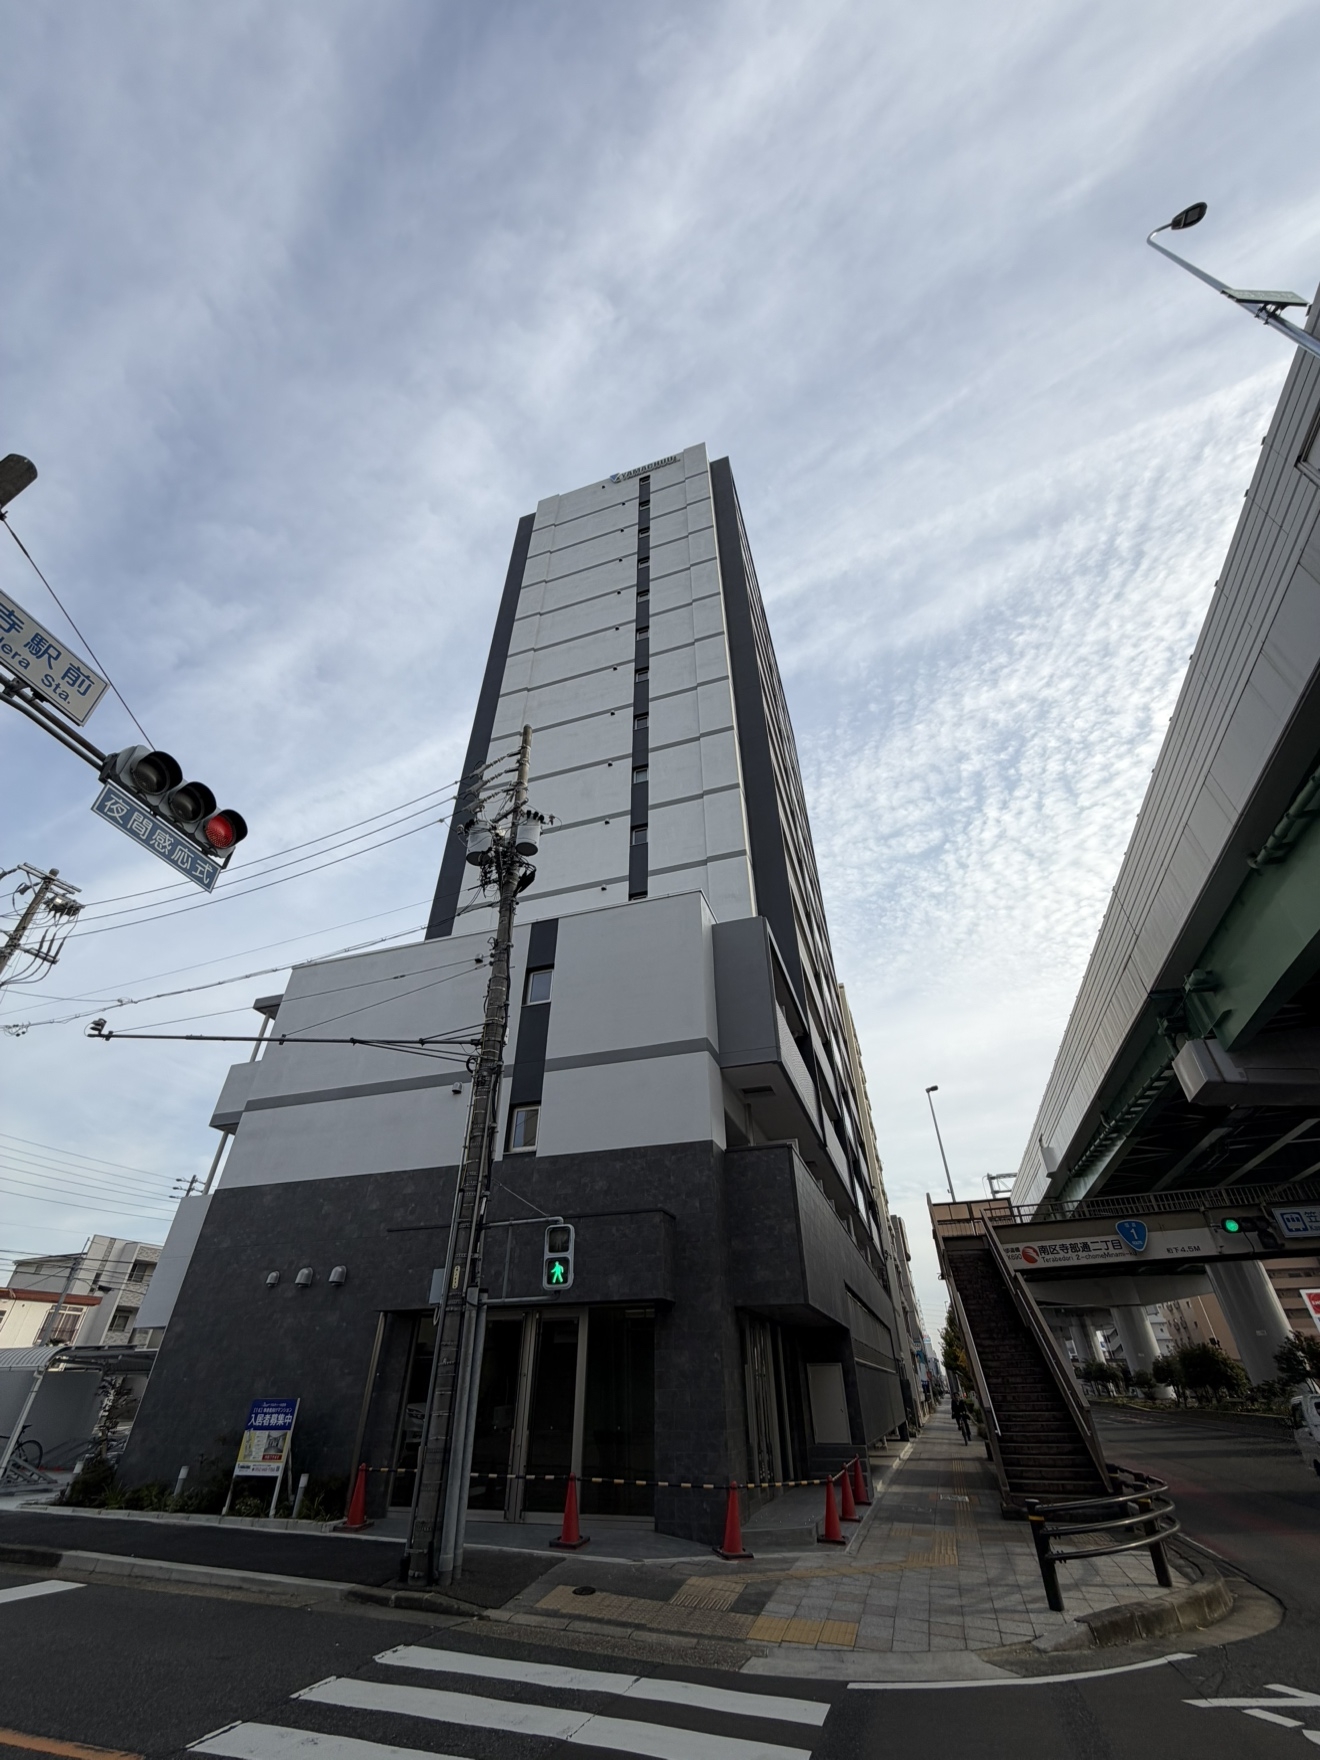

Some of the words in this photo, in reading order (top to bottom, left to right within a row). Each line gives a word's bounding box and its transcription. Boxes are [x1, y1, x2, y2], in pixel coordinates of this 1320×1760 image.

[0, 636, 31, 670] era
[41, 673, 71, 705] Sta.
[104, 794, 214, 885] 夜間感応式
[1130, 1228, 1138, 1240] 1
[1037, 1239, 1123, 1257] 南区寺部通二丁目
[247, 1413, 293, 1426] 入居者募集中
